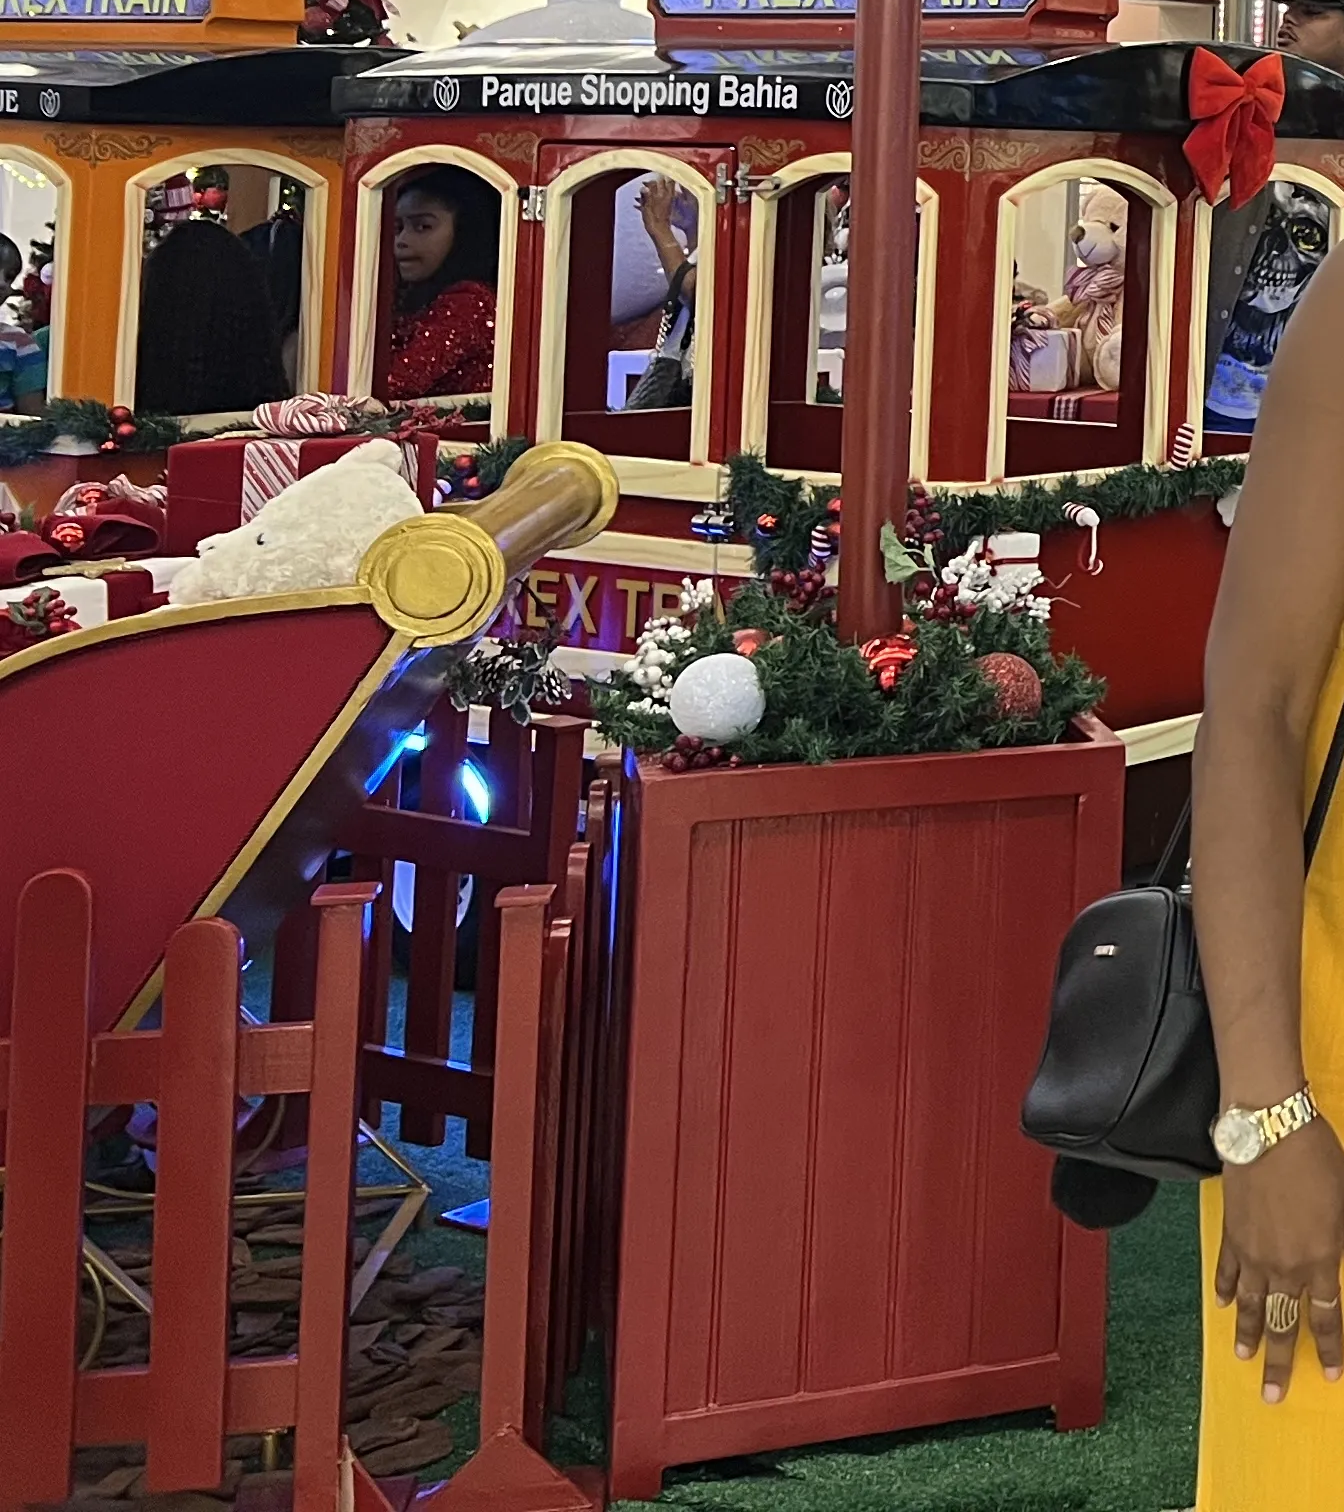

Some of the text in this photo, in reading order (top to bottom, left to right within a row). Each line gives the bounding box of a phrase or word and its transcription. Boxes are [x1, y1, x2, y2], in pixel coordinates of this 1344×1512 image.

[482, 74, 798, 114] Parque Shopping Bahia
